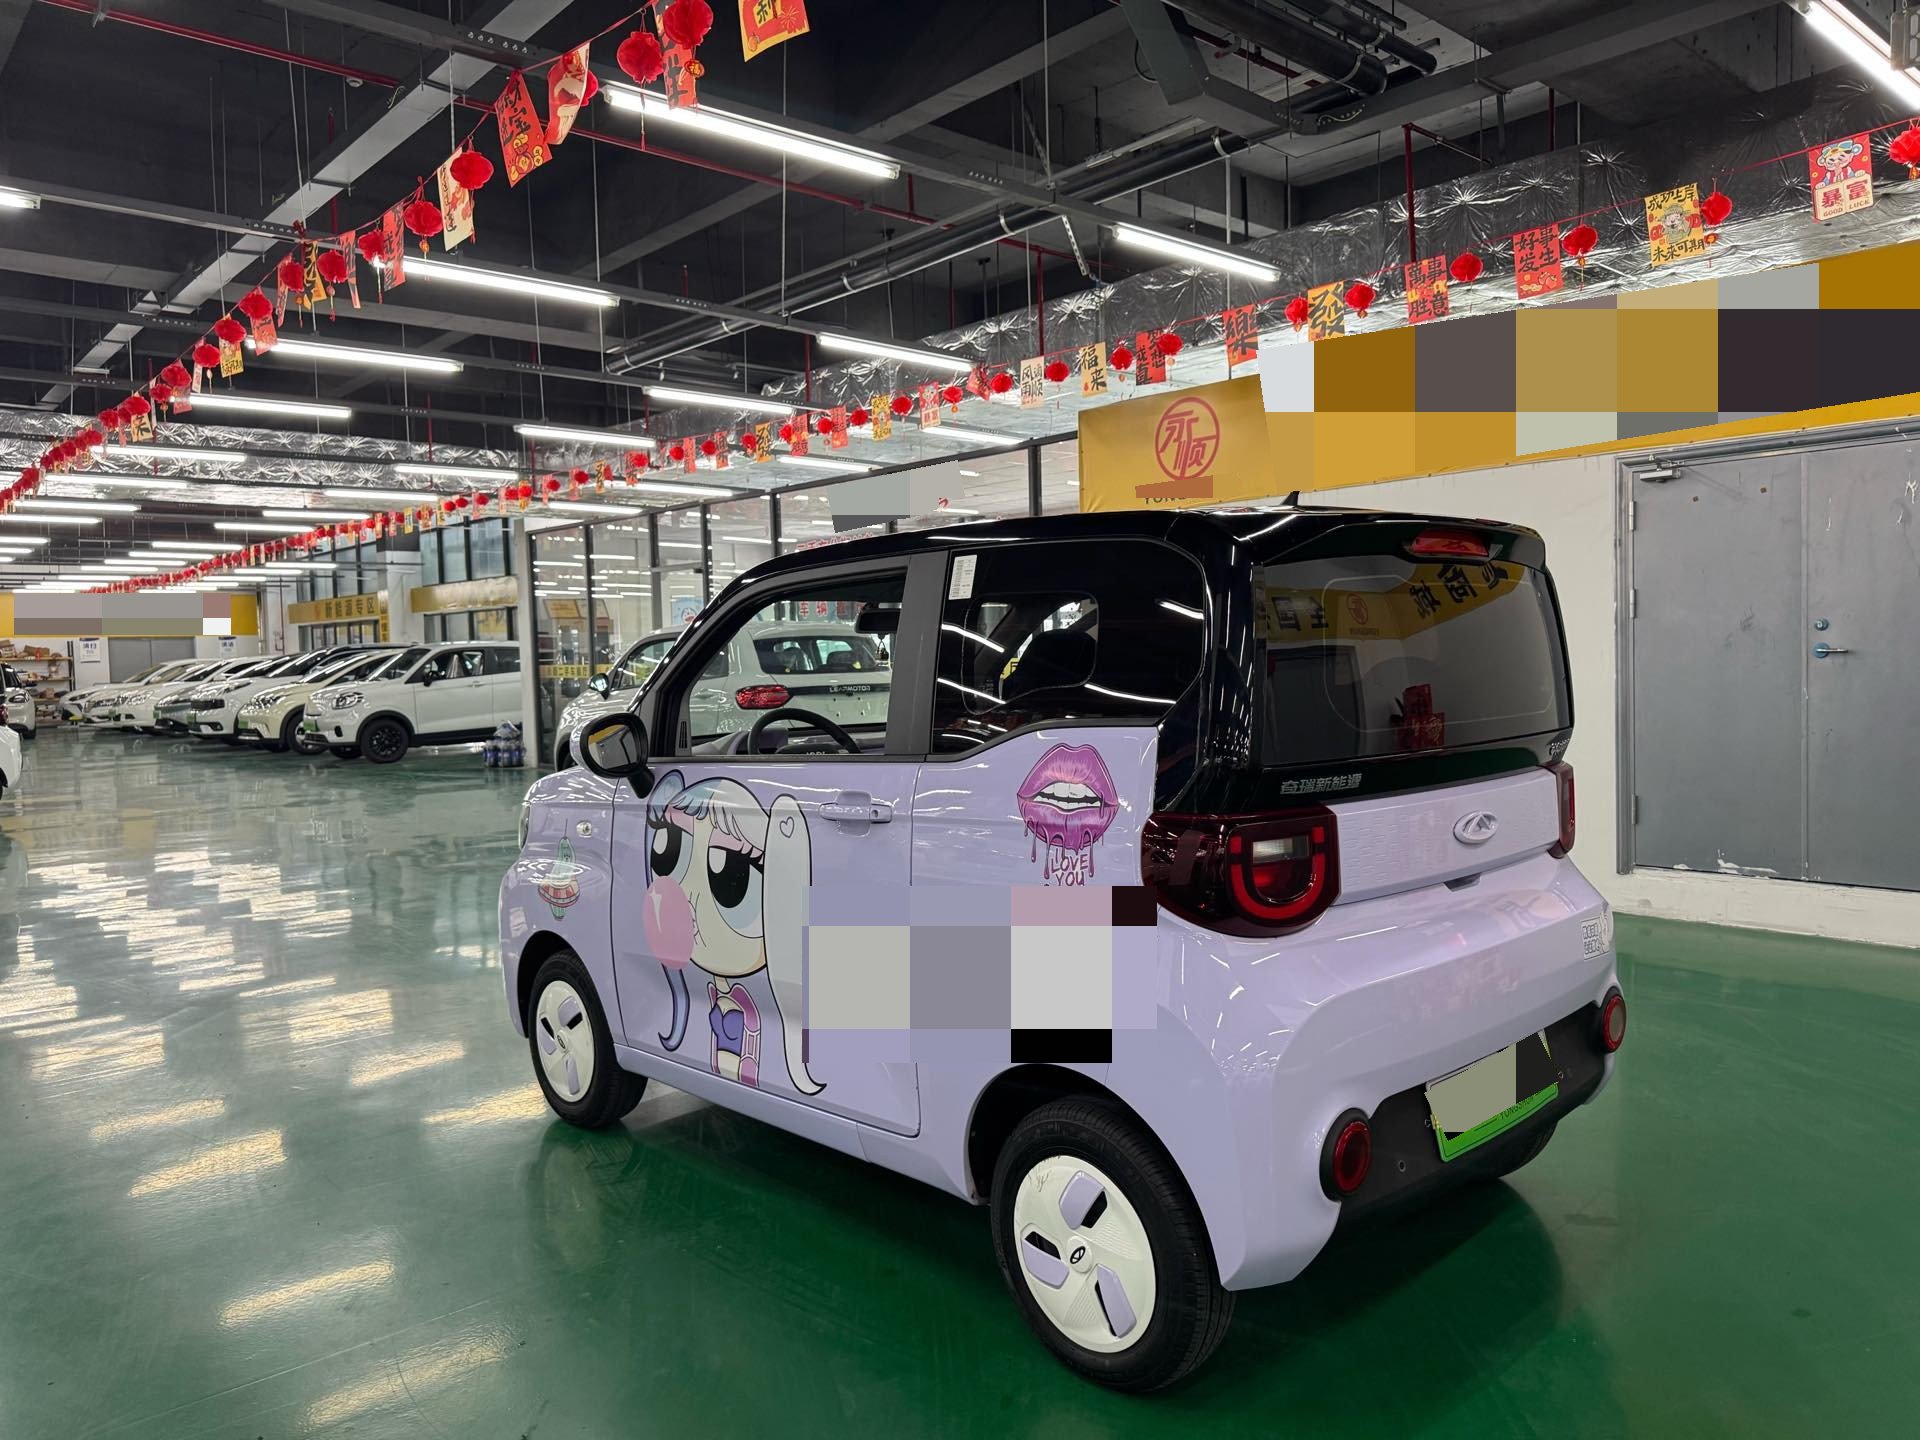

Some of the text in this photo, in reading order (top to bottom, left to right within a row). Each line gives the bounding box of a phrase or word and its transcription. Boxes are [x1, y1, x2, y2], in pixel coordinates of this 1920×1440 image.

[1648, 184, 1695, 211] 成功上岸
[1515, 224, 1557, 252] 好事
[1518, 247, 1559, 273] 发生
[1051, 854, 1089, 873] LOVE
[1055, 871, 1085, 886] YOU
